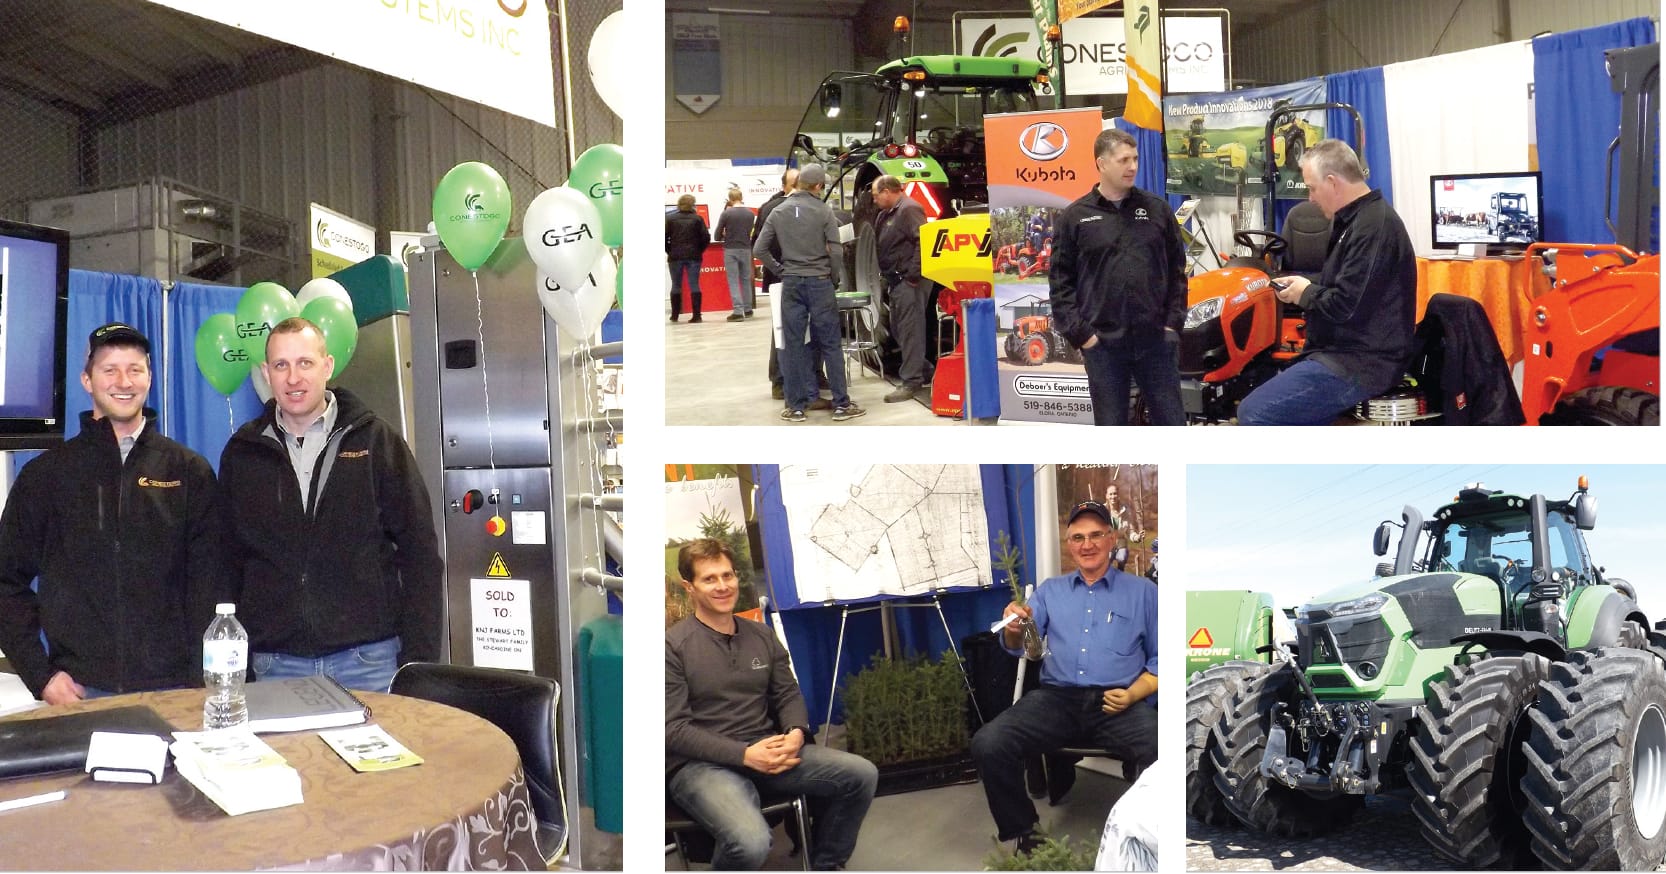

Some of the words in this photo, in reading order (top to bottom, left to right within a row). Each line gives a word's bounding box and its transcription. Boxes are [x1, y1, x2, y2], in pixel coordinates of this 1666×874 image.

[482, 16, 521, 56] INC
[1182, 102, 1209, 116] Product
[1208, 98, 1253, 115] Innovations
[1253, 97, 1273, 111] 2018
[1016, 166, 1077, 183] Kubota
[541, 223, 594, 248] GEA
[236, 322, 272, 339] GEA
[1020, 382, 1052, 391] Deboer's
[1023, 400, 1093, 413] 519-846-5388
[485, 590, 515, 602] SOLD
[493, 607, 513, 618] TO:
[489, 627, 511, 636] FARMS
[512, 629, 525, 637] LTD
